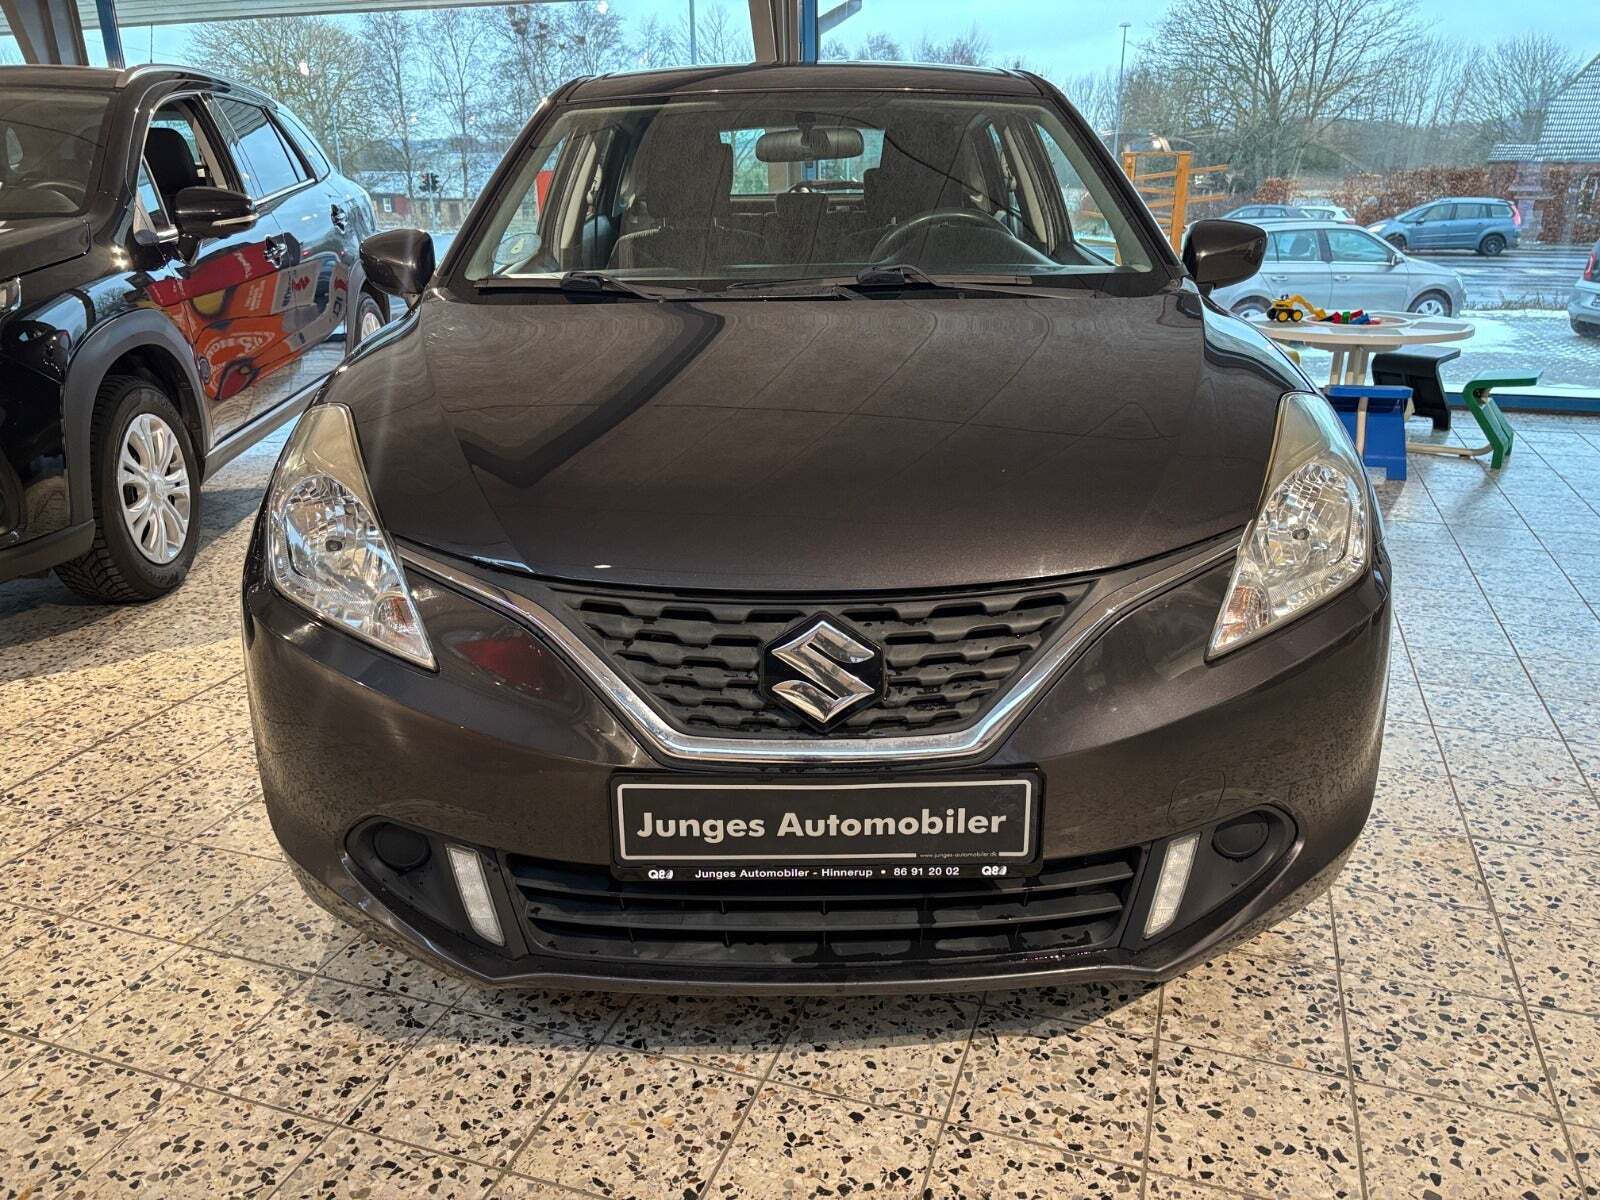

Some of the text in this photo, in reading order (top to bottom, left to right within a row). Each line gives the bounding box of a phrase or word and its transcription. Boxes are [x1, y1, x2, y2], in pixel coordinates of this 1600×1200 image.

[636, 807, 1007, 844] Junges Automobiler
[694, 869, 737, 880] Junges
[739, 868, 810, 878] Automobiler
[821, 868, 873, 878] Hinnerup
[893, 867, 908, 876] 86
[910, 867, 923, 876] 91
[928, 866, 943, 876] 20
[945, 866, 960, 876] 02
